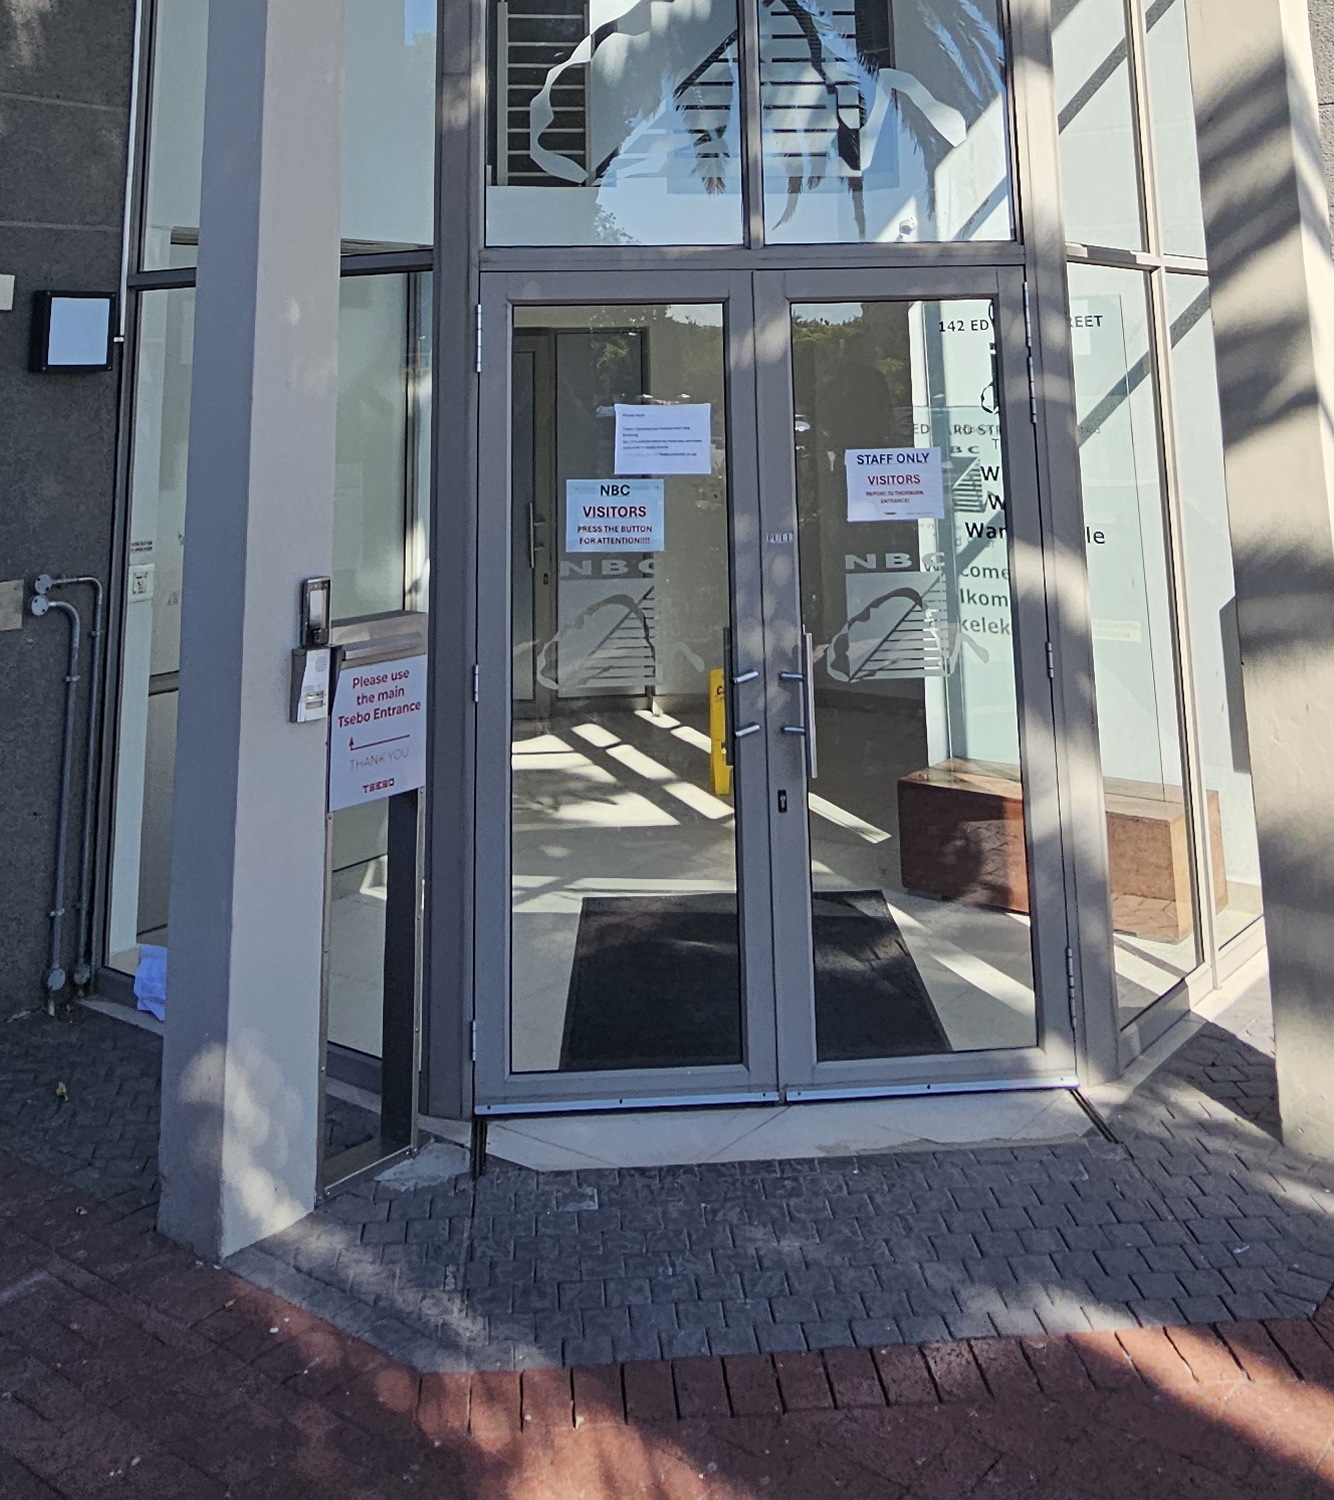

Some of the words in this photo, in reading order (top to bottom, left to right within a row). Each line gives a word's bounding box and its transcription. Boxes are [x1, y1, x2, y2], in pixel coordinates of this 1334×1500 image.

[938, 319, 965, 333] 142
[857, 453, 893, 465] STAFF
[896, 452, 929, 464] ONLY
[868, 474, 921, 486] VISITORS
[600, 484, 631, 497] NBC
[582, 506, 647, 518] VISITORS
[577, 525, 603, 533] PRESS
[604, 525, 619, 533] THE
[621, 525, 652, 533] BUTTON
[579, 537, 596, 545] FOR
[352, 673, 389, 690] Please
[391, 669, 410, 681] use
[356, 691, 375, 706] the
[378, 685, 405, 703] main
[337, 708, 370, 728] Tsebo
[373, 700, 422, 720] Entrance
[349, 751, 385, 771] THANK
[387, 747, 410, 762] YOU
